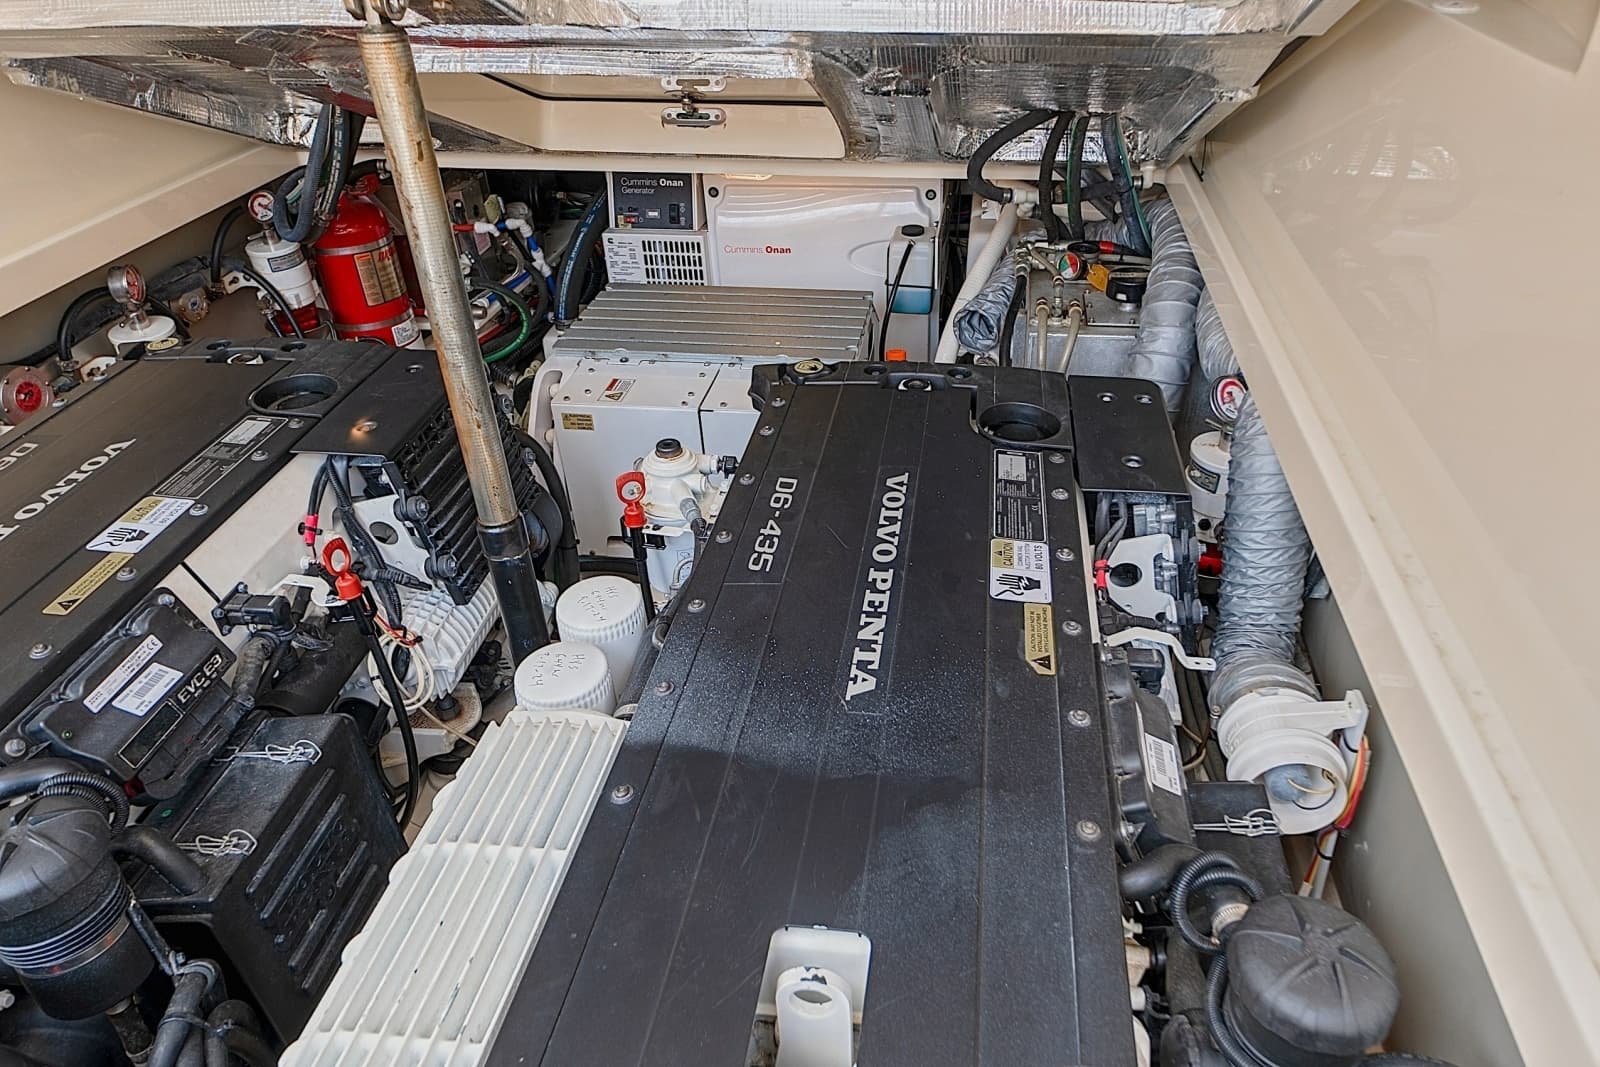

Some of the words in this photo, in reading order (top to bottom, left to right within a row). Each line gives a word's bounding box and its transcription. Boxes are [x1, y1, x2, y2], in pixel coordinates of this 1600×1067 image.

[620, 178, 658, 186] Cummins
[660, 178, 684, 186] Onan
[724, 244, 764, 254] Cummins
[765, 246, 791, 254] Onan
[14, 438, 136, 520] VOLVO
[748, 477, 798, 572] D6-435
[872, 472, 909, 562] VOLVO
[1002, 542, 1012, 566] CAUTION
[1033, 544, 1042, 561] VOLTS
[846, 568, 894, 700] PENTA
[178, 672, 206, 702] EVC
[203, 654, 222, 676] E3
